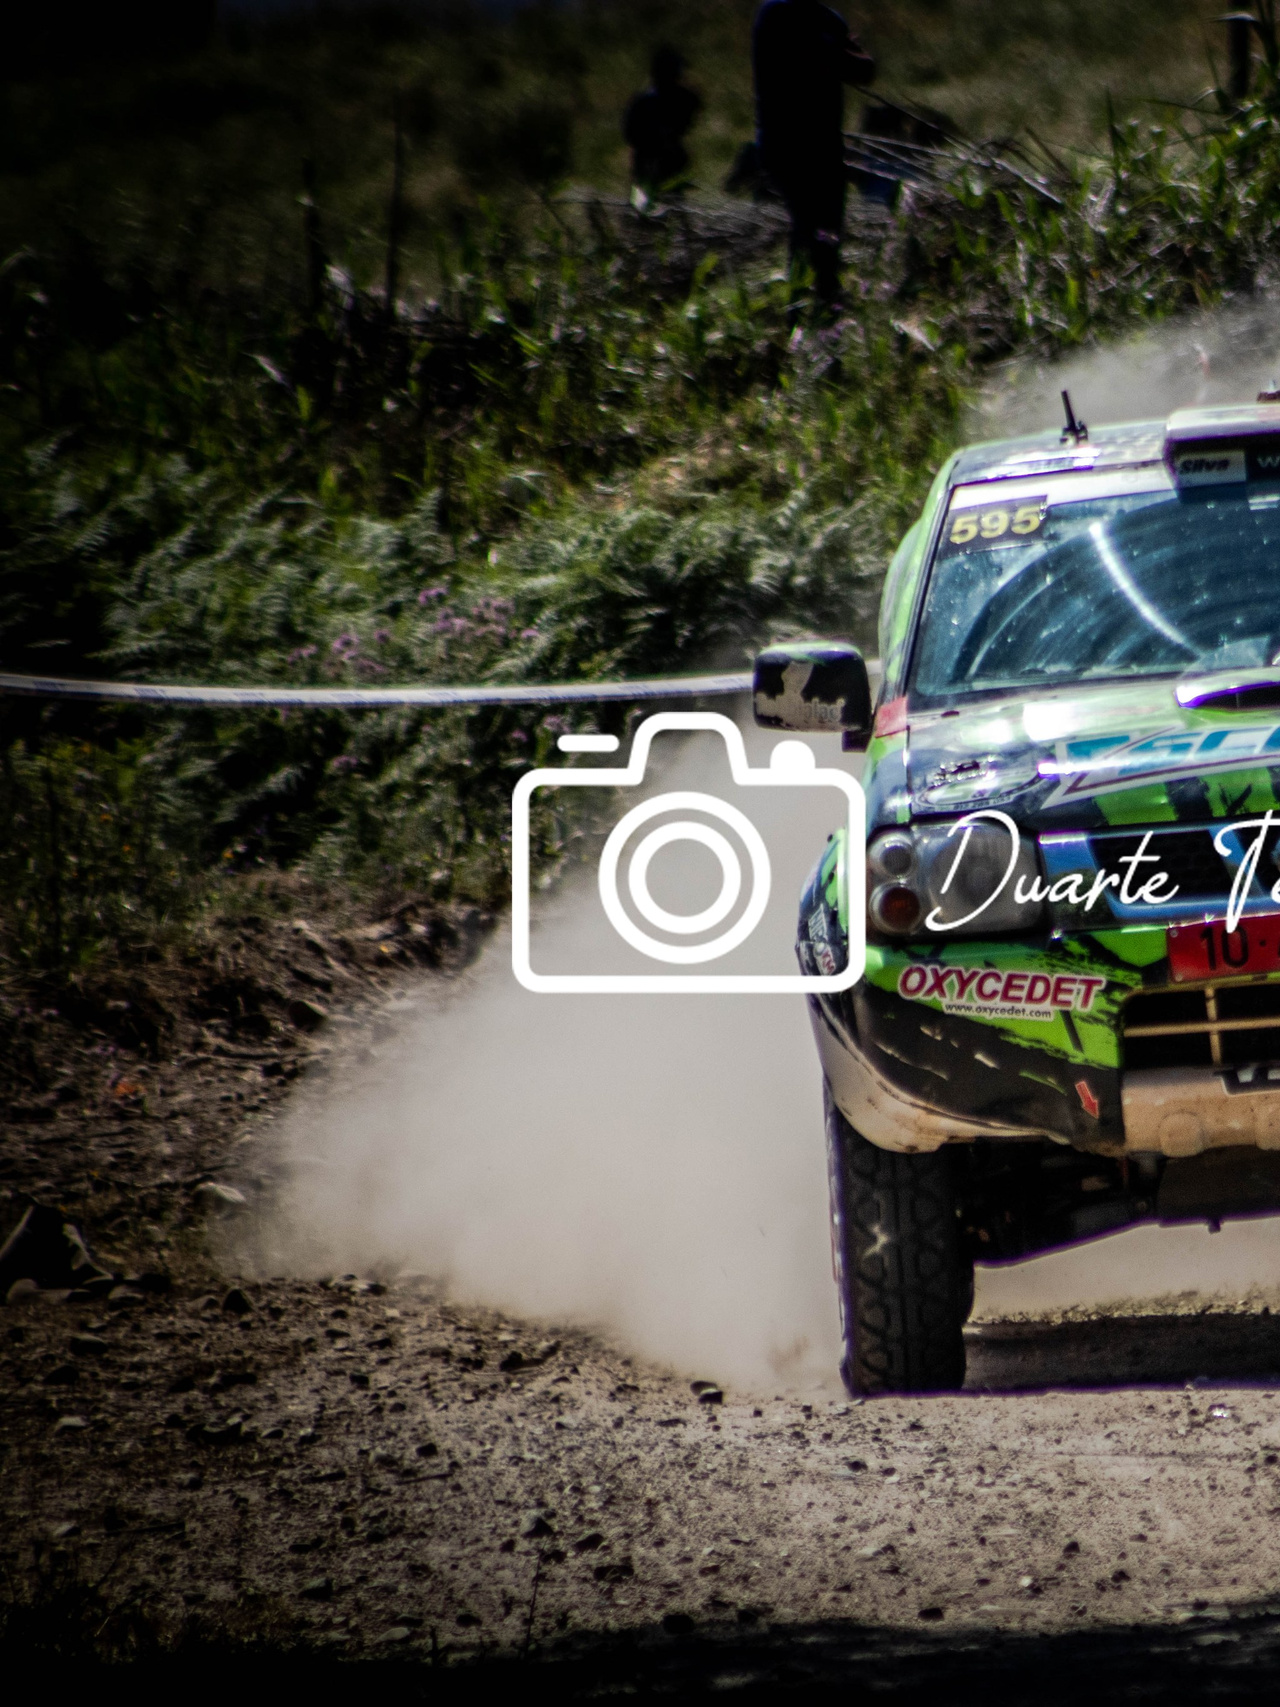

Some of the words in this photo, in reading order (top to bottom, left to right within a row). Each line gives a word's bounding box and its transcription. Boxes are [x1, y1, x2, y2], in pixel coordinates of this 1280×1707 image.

[949, 505, 1042, 544] 595
[900, 965, 1104, 1010] OXYCEDET
[945, 1002, 1052, 1020] www.oxycedet.com
